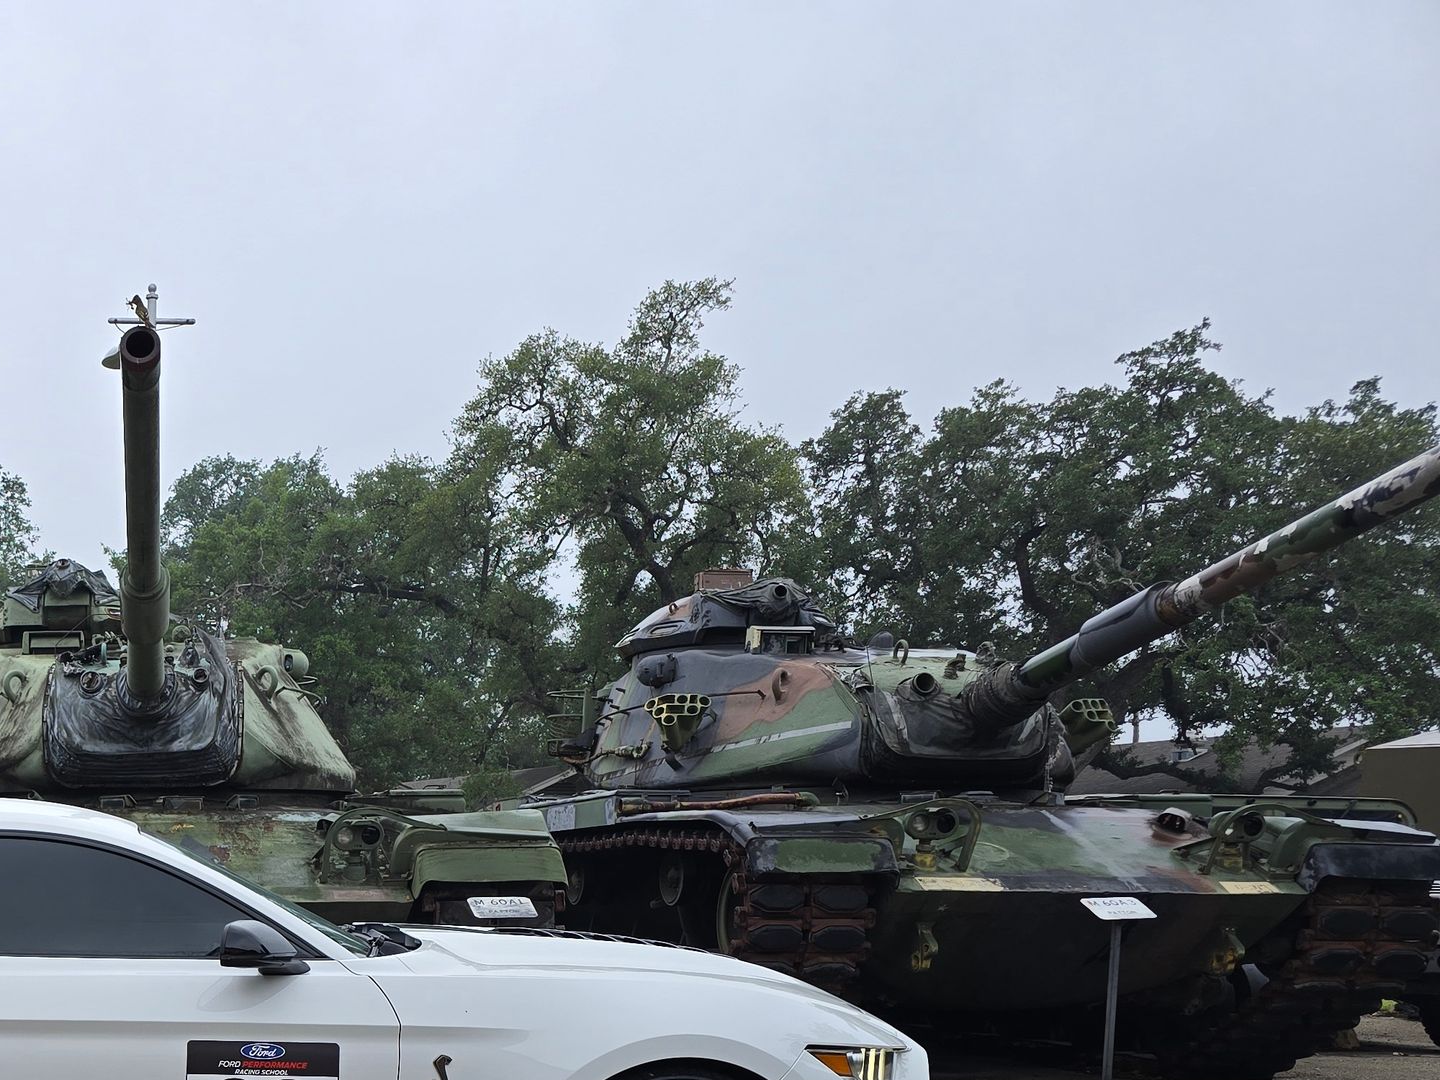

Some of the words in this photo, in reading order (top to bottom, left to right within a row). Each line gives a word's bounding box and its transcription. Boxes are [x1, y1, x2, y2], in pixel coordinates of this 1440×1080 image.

[247, 1044, 278, 1058] Ford
[217, 1060, 241, 1068] FORD
[241, 1061, 308, 1069] PERFORMANCE
